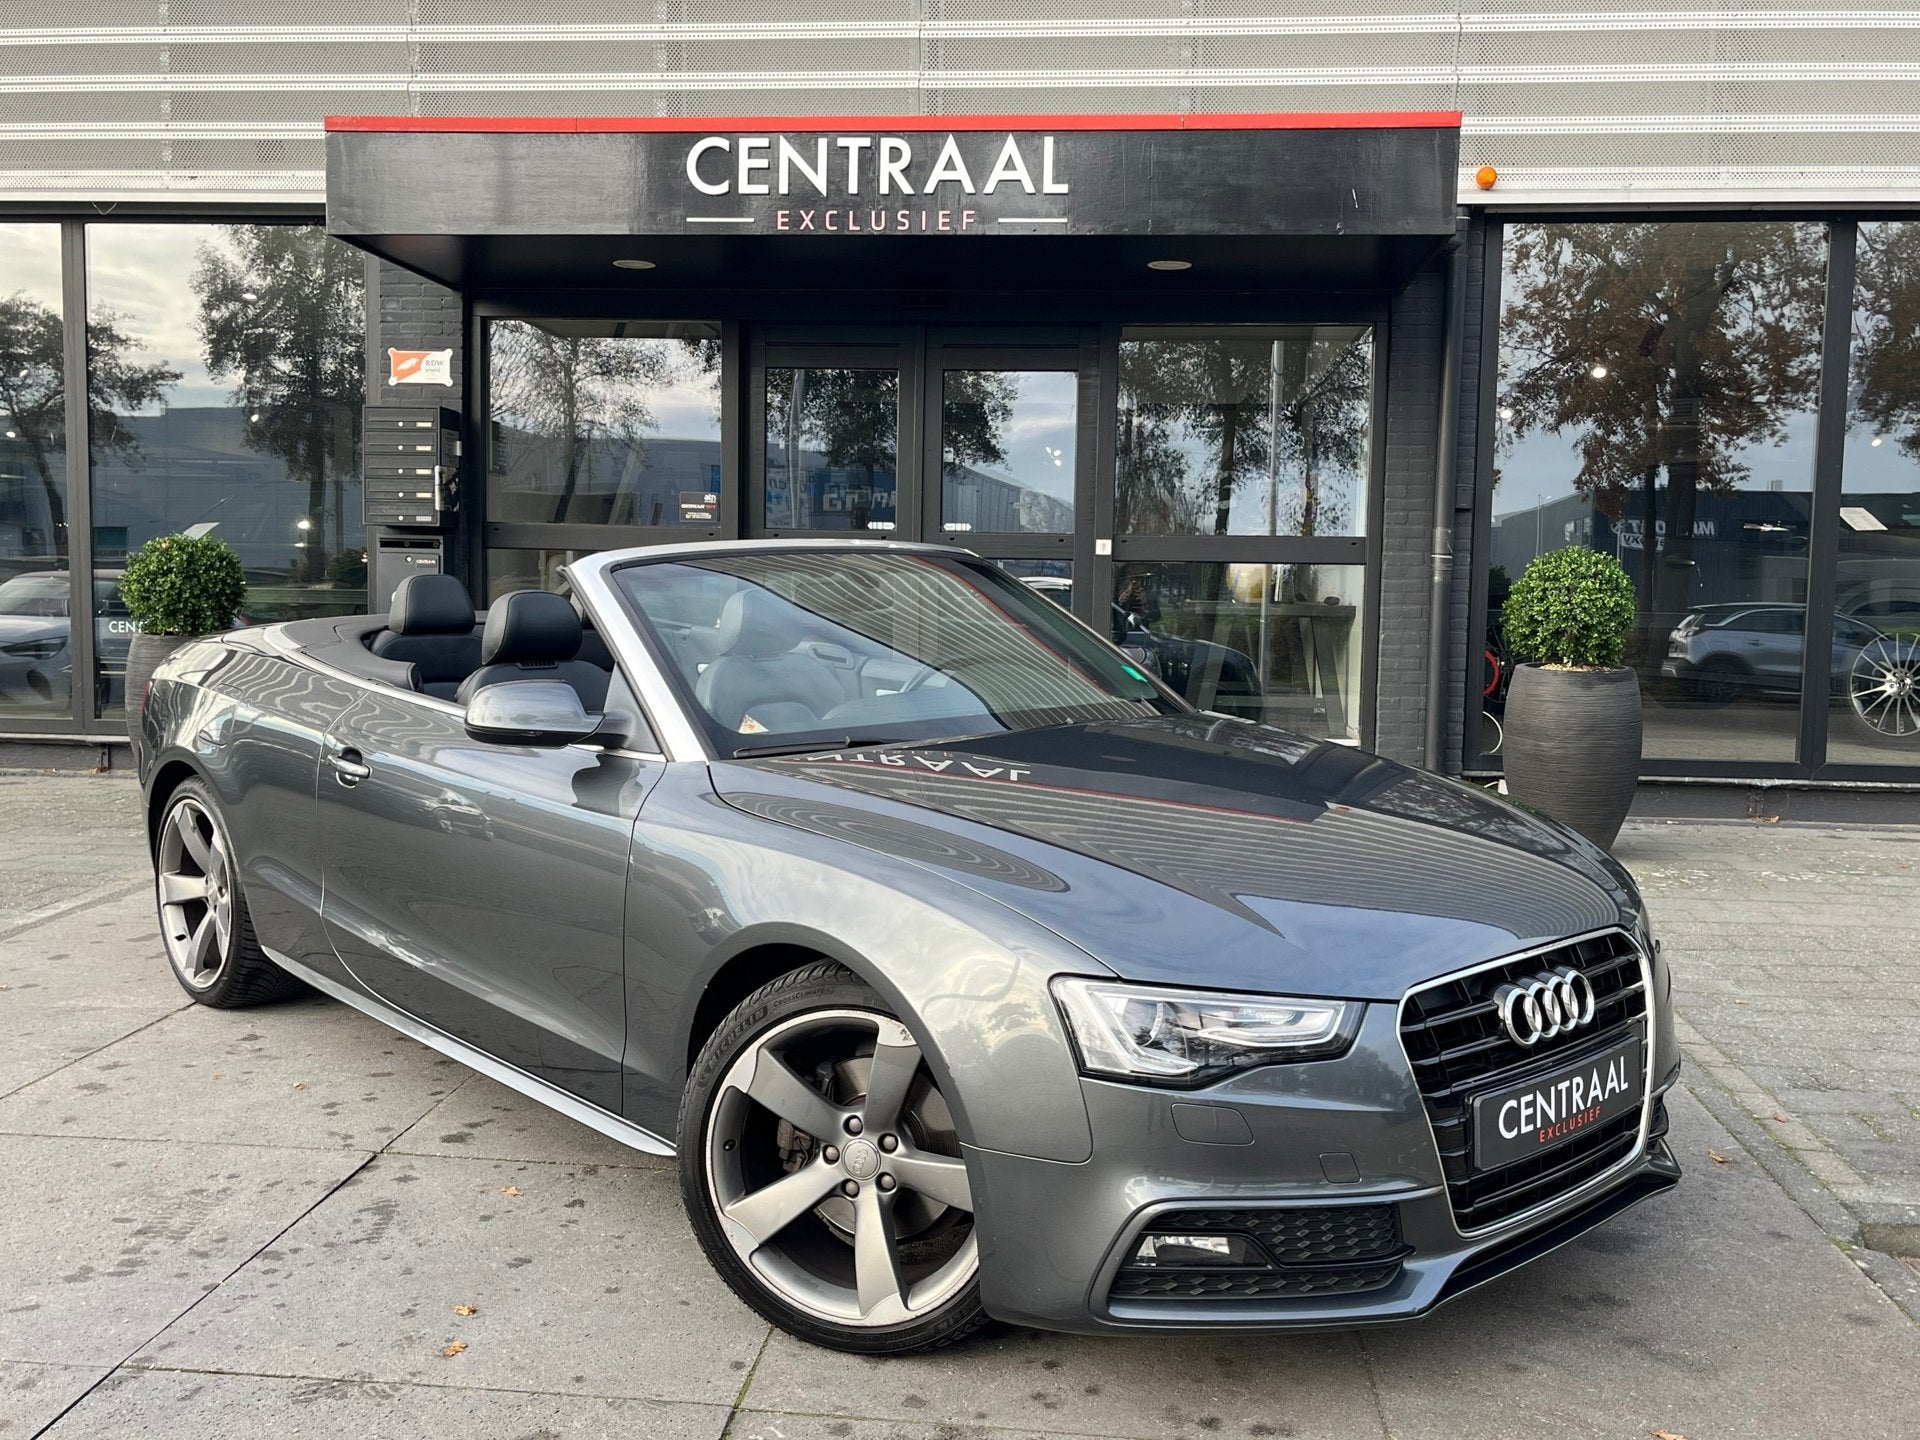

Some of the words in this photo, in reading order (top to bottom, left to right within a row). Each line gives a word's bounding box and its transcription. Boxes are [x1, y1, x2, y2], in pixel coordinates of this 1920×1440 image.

[686, 133, 1069, 197] CENTRAAL
[776, 210, 976, 231] EXCLUSIEF
[1498, 1055, 1629, 1140] CENTRAAL
[1539, 1105, 1601, 1144] EXCLUSIEF
